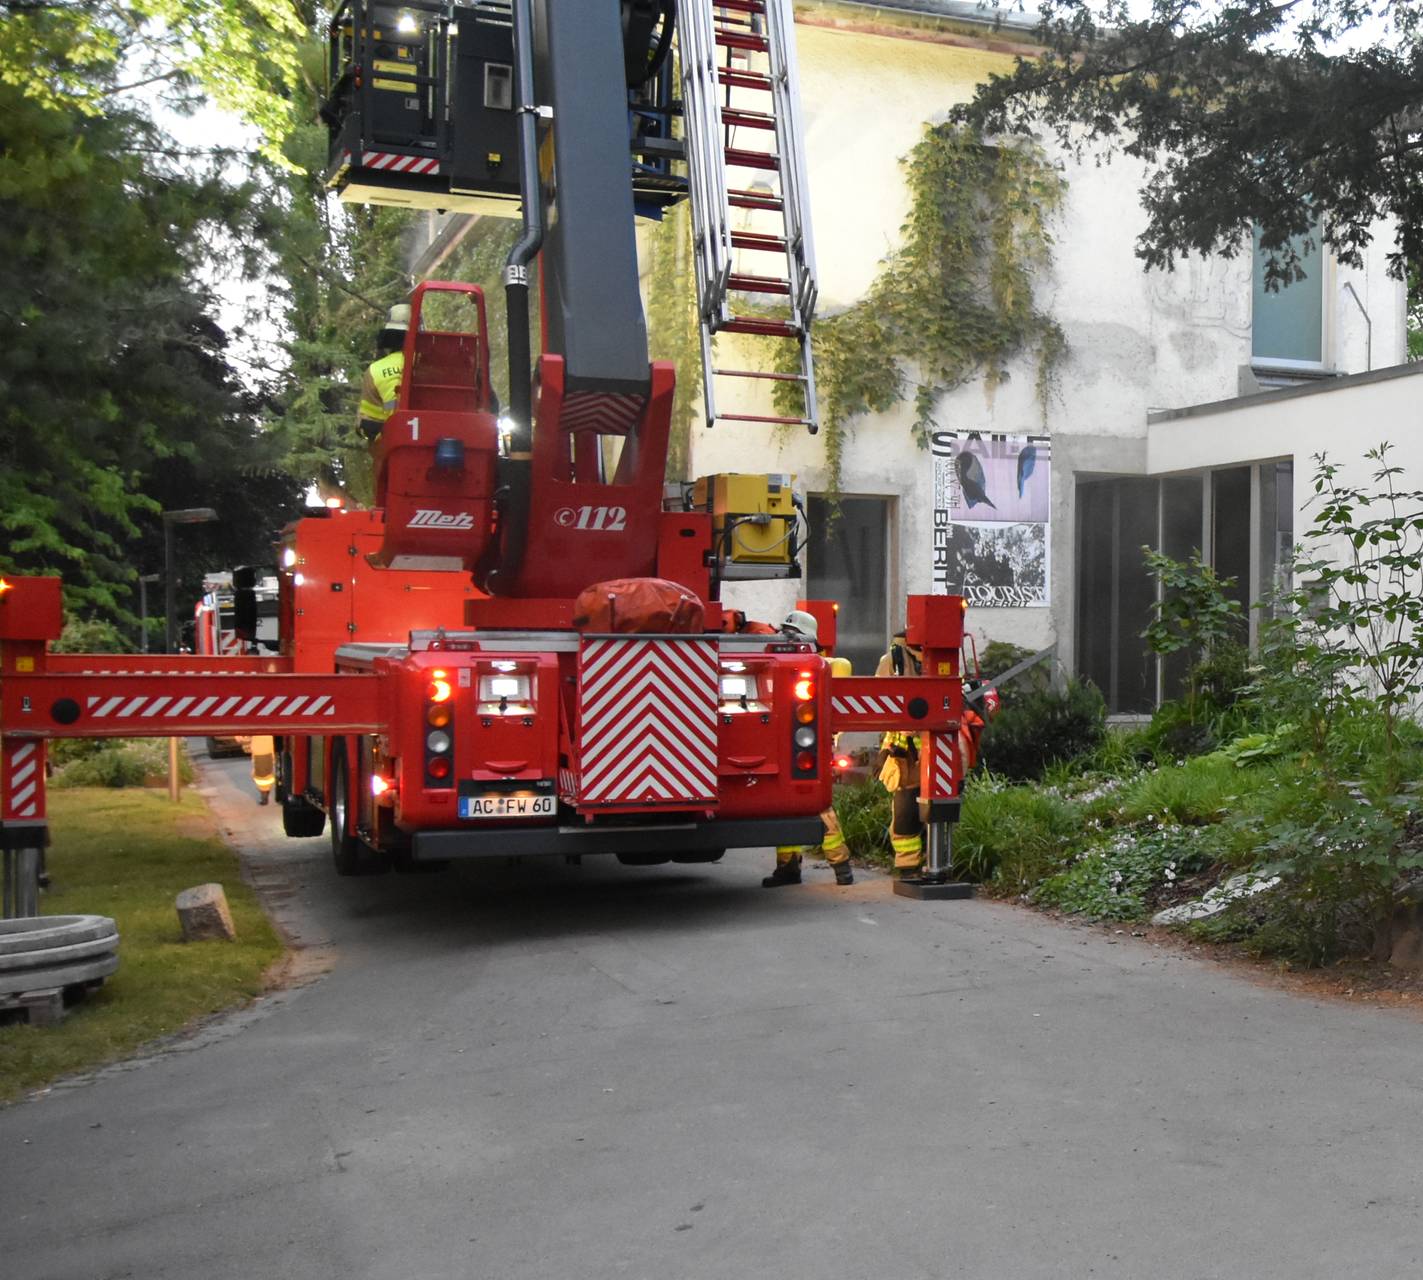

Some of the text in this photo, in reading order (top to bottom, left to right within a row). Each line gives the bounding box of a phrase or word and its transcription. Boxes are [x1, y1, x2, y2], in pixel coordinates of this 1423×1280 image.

[382, 366, 402, 378] FEU
[407, 417, 419, 440] 1
[406, 509, 474, 529] Metz
[575, 506, 626, 531] 112
[933, 509, 949, 588] BERIT
[963, 585, 1044, 601] TOURIST
[473, 798, 552, 814] AC FW 60
